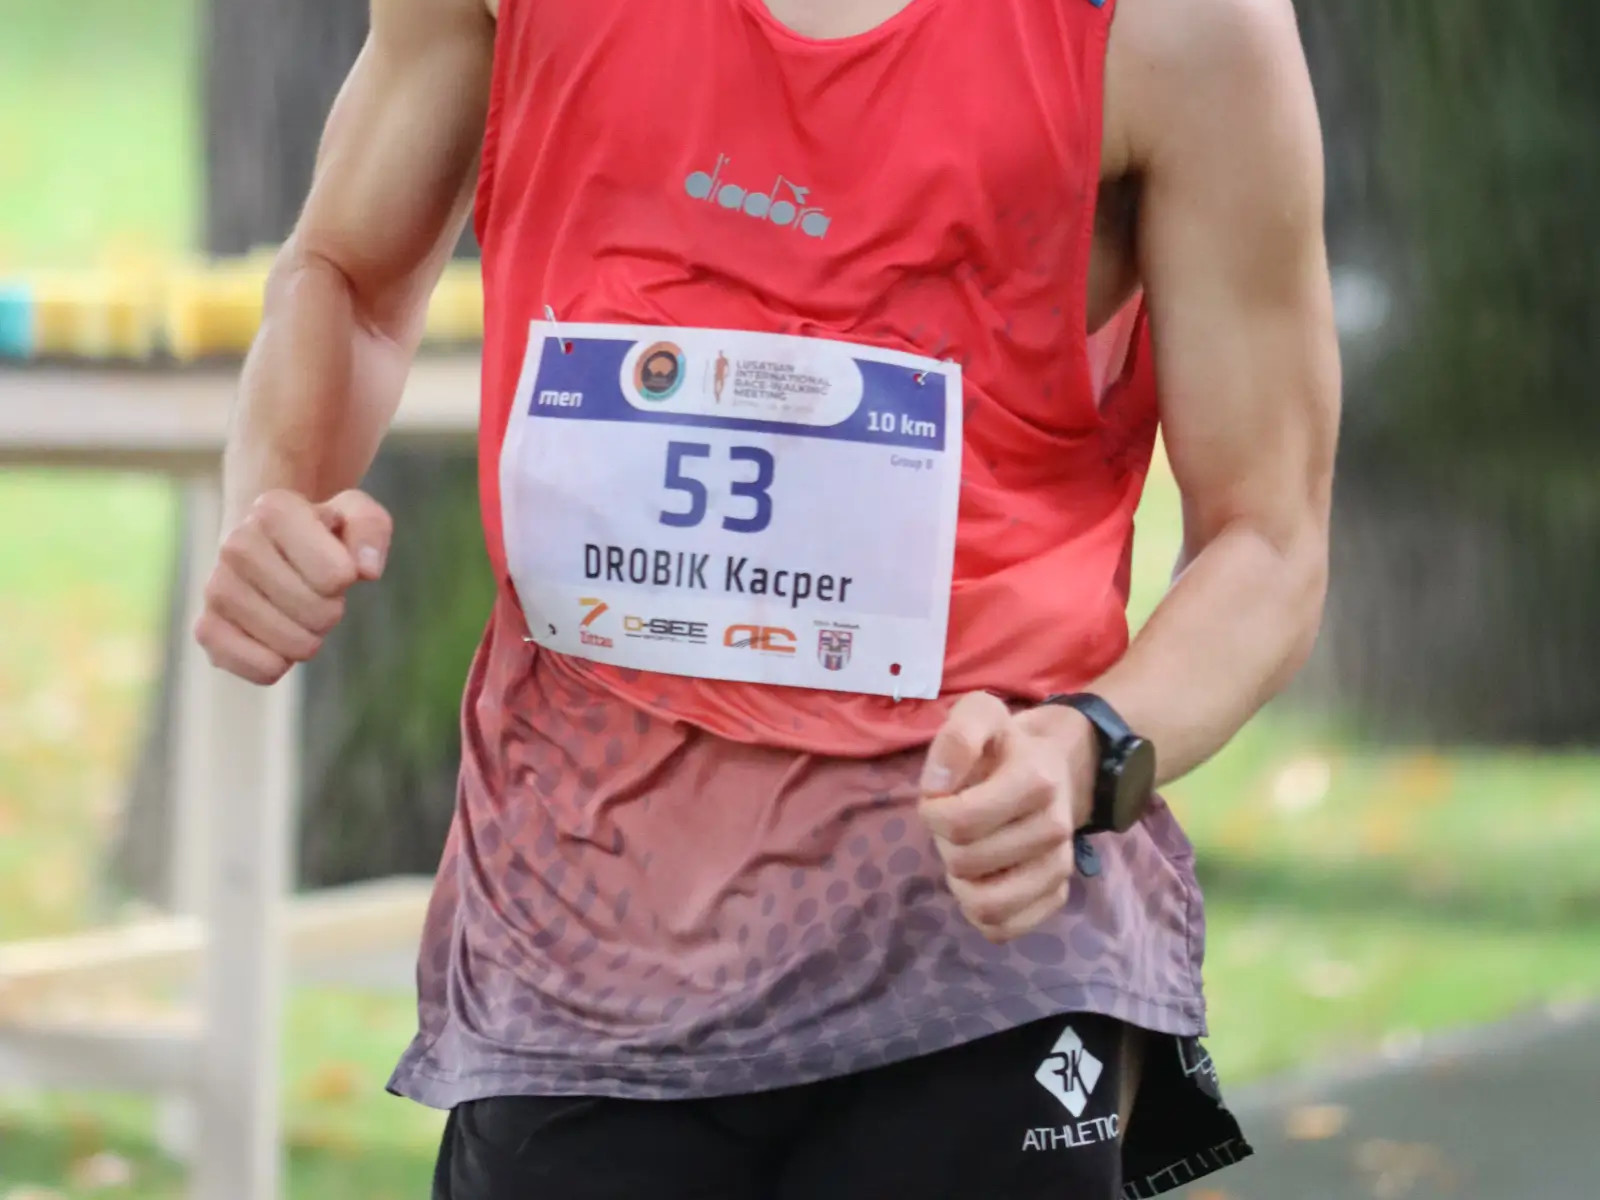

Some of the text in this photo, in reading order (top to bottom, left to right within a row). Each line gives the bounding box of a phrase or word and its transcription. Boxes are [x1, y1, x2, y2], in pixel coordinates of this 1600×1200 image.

[685, 153, 832, 240] diadora
[538, 390, 584, 408] men
[866, 411, 937, 438] 10 km
[658, 440, 775, 534] 53
[584, 543, 853, 608] DROBIK Kacper
